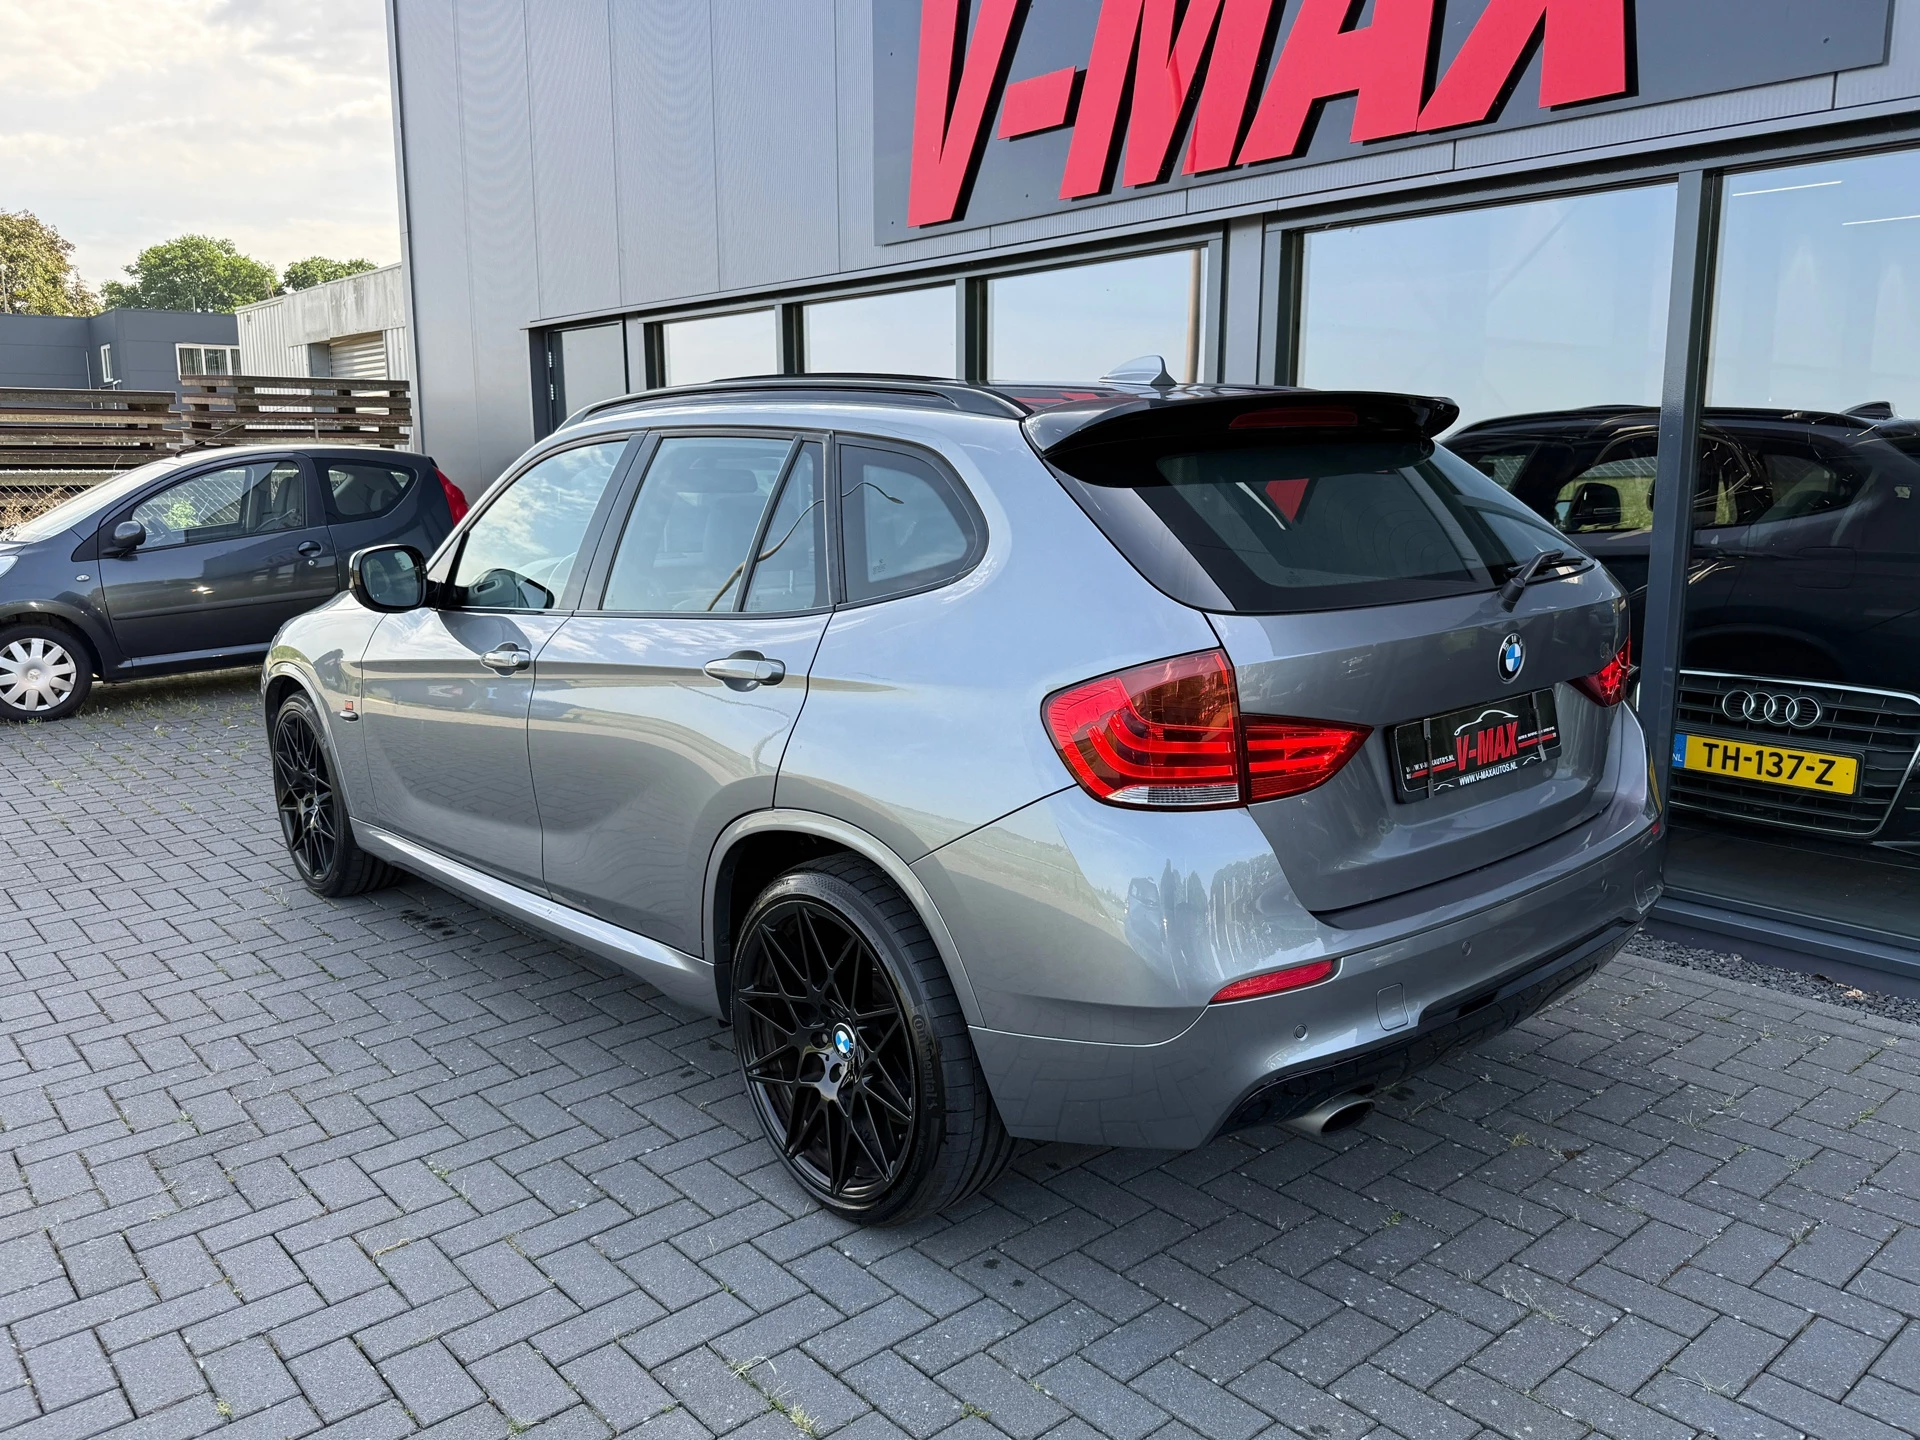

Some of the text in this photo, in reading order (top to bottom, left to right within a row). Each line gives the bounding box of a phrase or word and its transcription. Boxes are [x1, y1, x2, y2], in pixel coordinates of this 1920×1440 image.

[1456, 720, 1518, 771] V-MAX
[1672, 753, 1683, 762] NL
[1458, 761, 1518, 786] WWW.V-MAXAUTOS.NL
[1702, 742, 1836, 786] TH-137-Z
